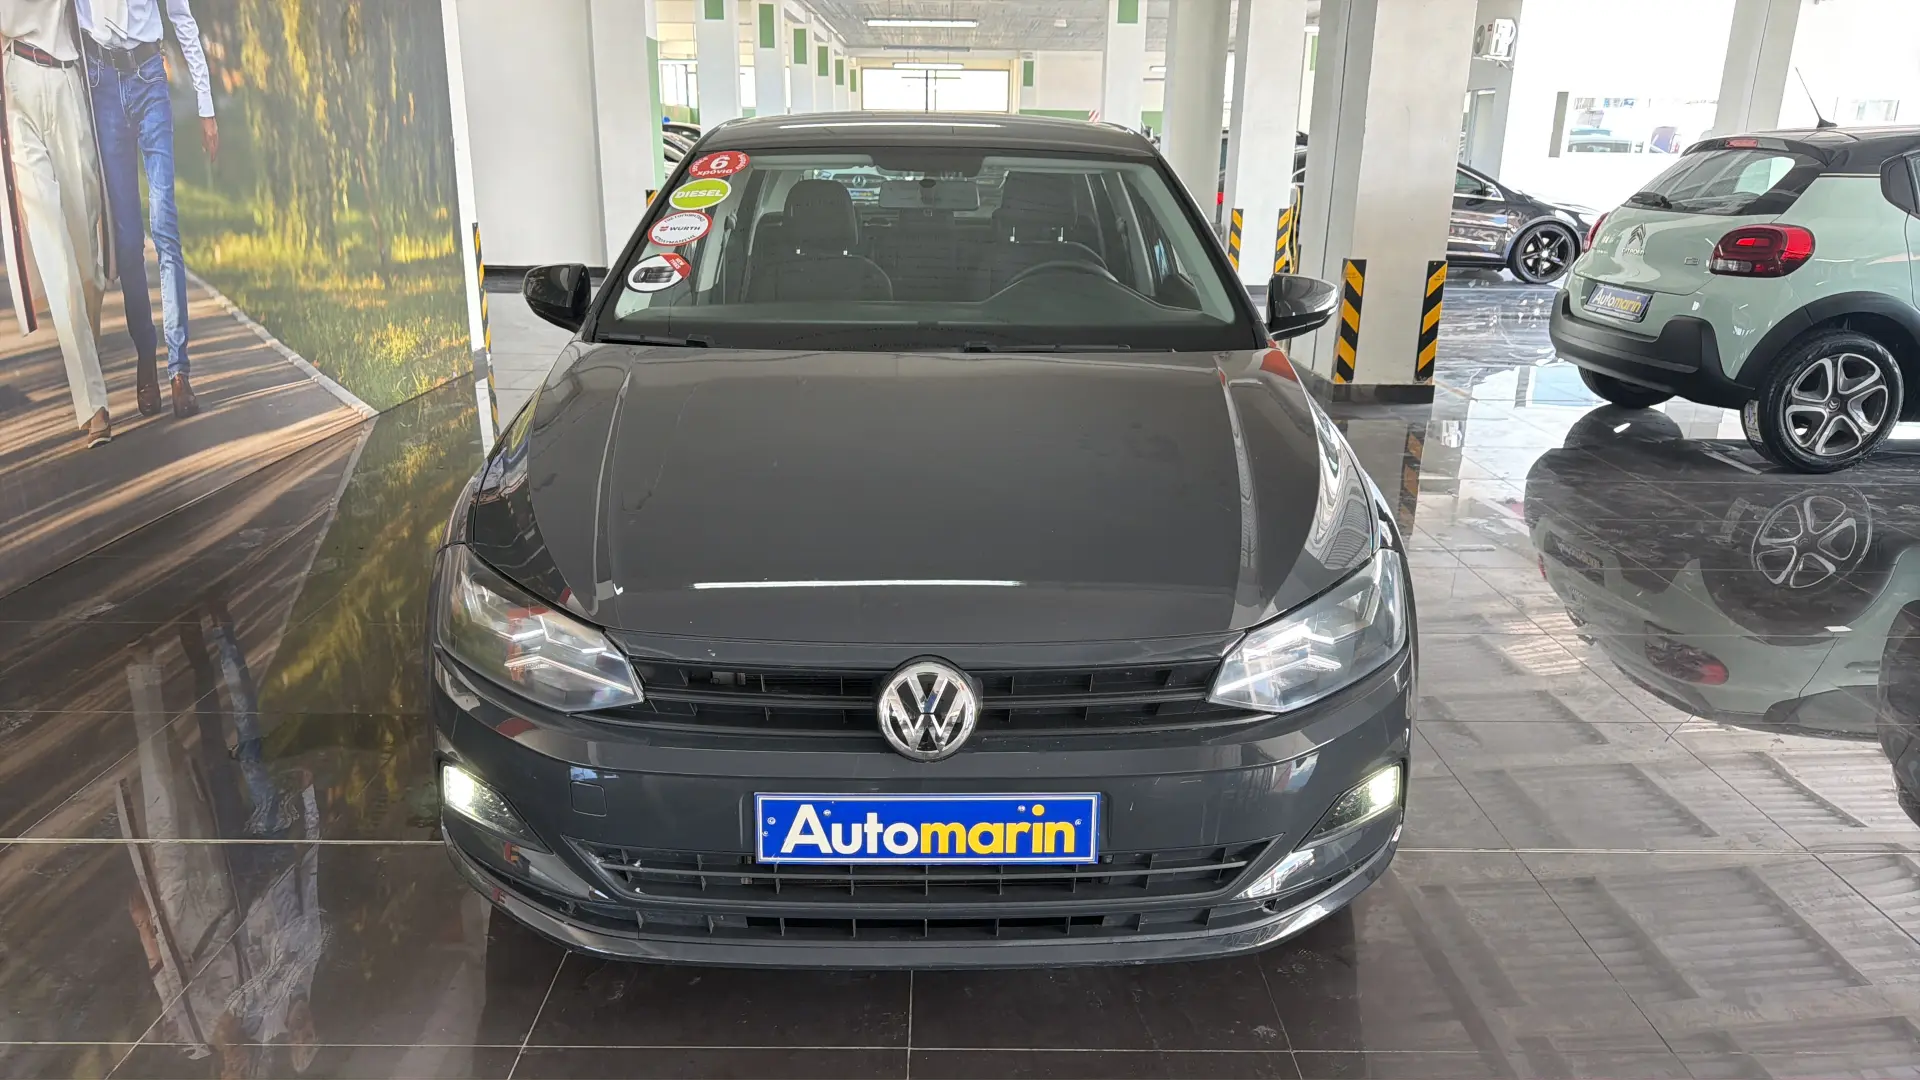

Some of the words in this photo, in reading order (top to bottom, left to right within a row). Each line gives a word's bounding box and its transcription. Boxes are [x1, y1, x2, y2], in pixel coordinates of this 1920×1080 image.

[710, 156, 731, 170] 6
[674, 189, 724, 199] DIESEL
[1591, 287, 1643, 313] Automarin
[780, 803, 1076, 855] Automarin
